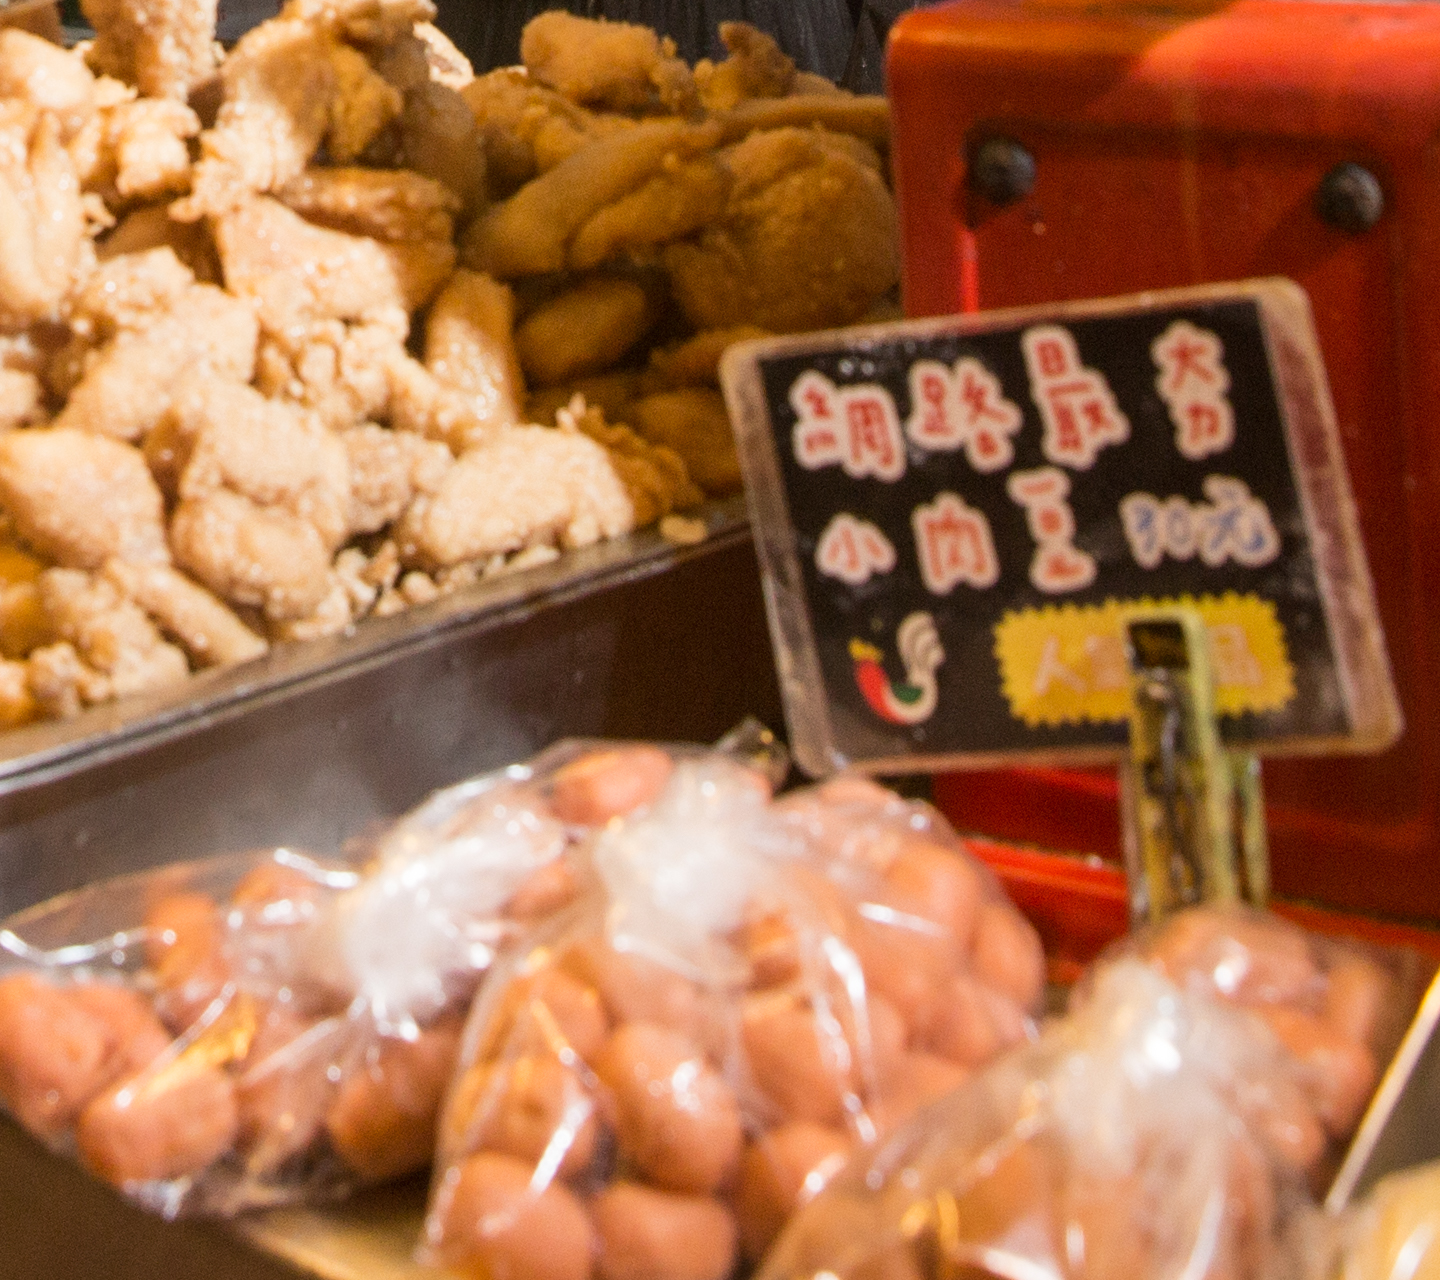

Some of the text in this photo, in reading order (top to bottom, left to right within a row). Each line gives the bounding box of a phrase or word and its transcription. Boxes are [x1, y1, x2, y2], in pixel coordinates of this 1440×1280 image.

[811, 467, 1281, 595] 小肉豆 30元
